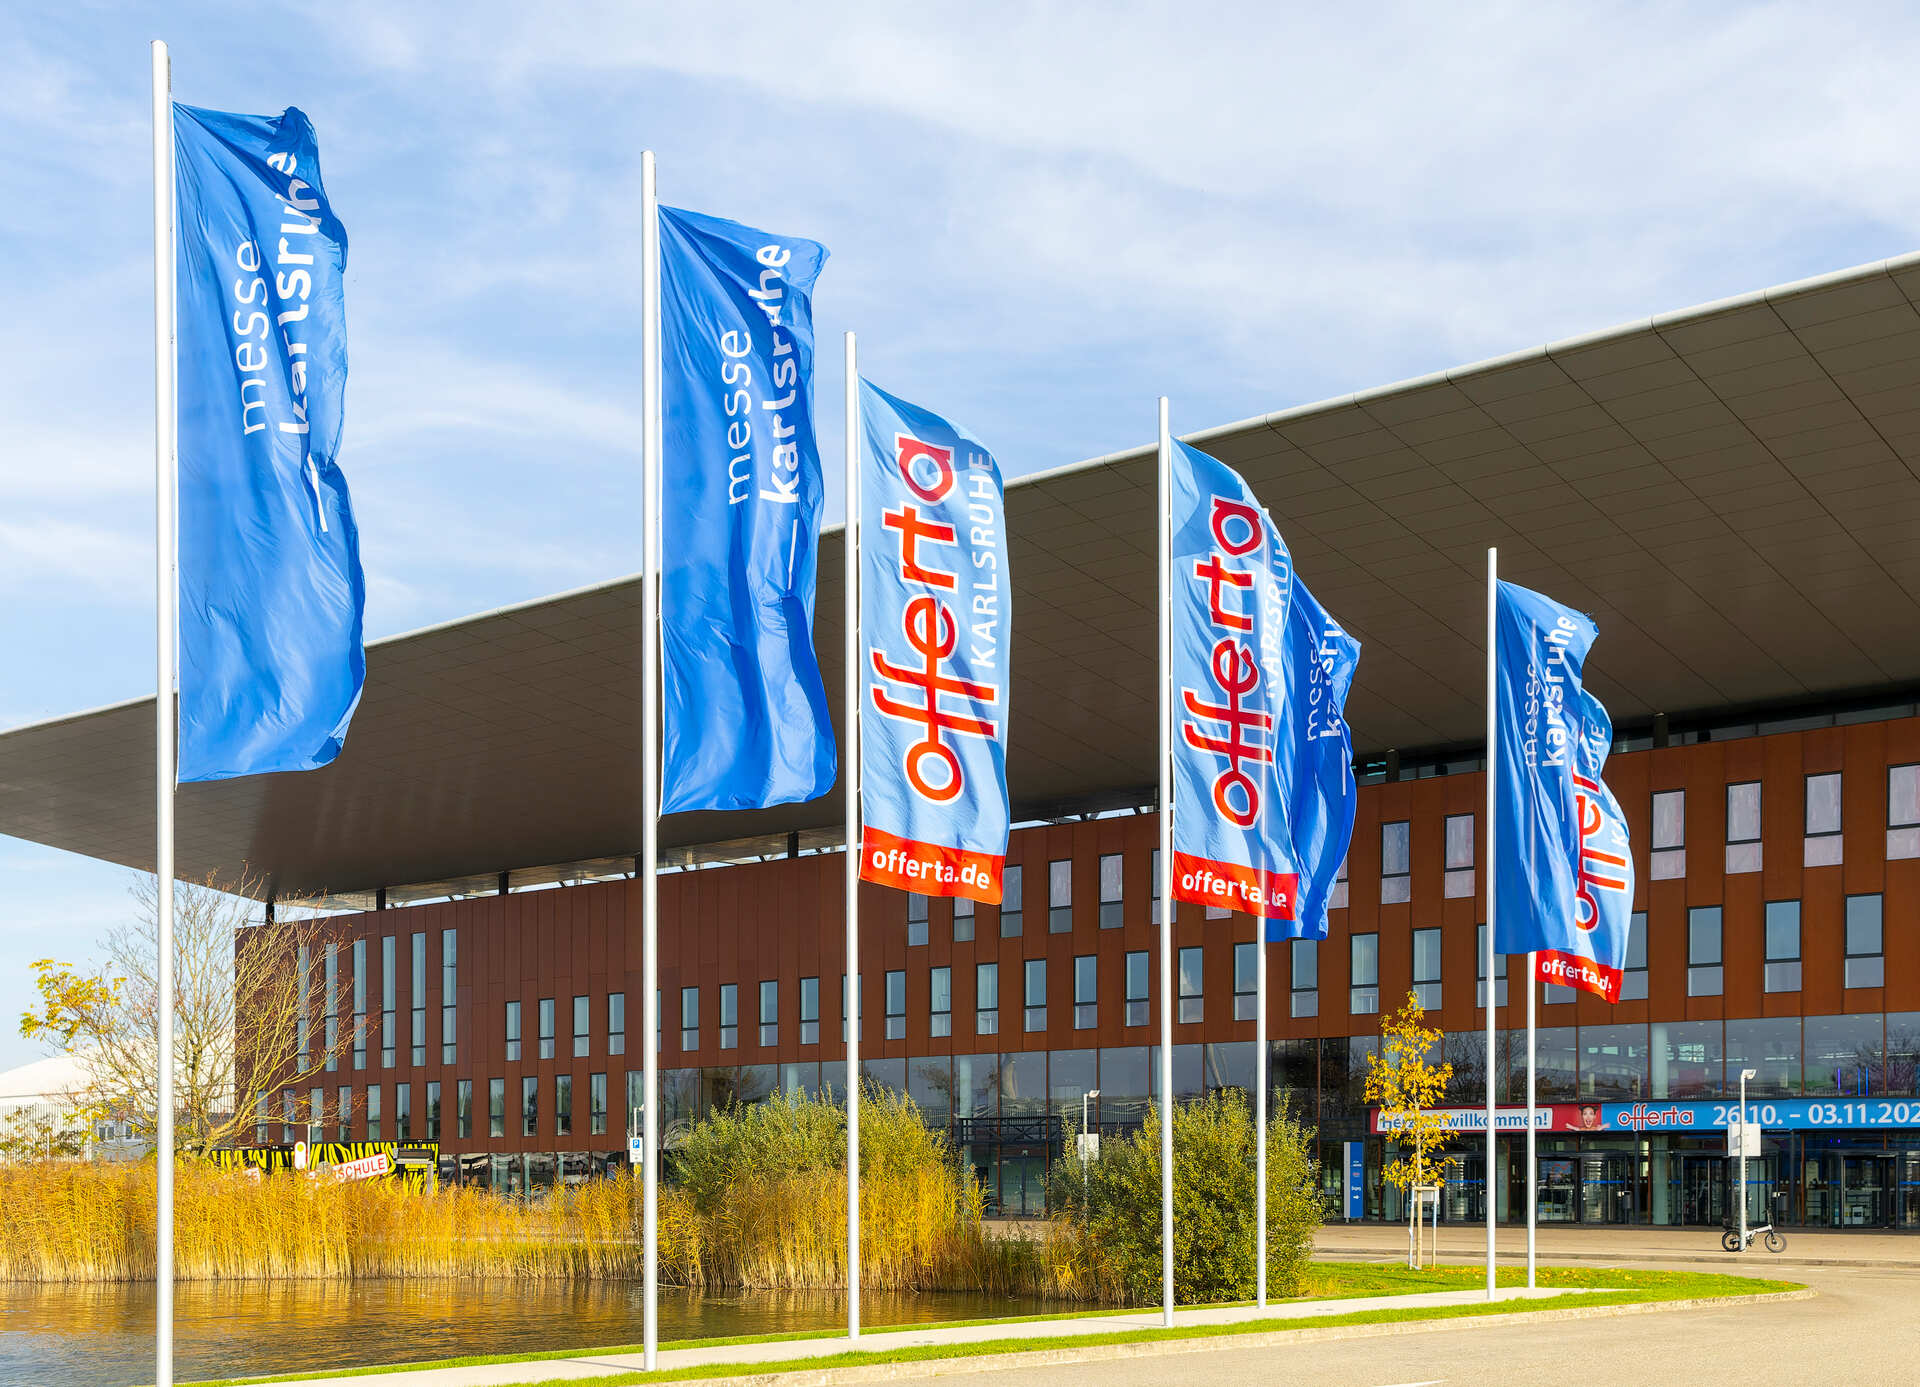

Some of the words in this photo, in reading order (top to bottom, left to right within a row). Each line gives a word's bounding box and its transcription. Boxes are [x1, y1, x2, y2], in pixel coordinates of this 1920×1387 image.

[233, 239, 269, 435] messe
[721, 329, 752, 505] messe
[870, 432, 999, 806] offerta
[968, 451, 998, 669] KARLSRUHE
[1260, 532, 1290, 699] KARLSRUH
[1180, 493, 1276, 831] offerta
[1525, 663, 1541, 768] messe
[1541, 615, 1579, 767] karlsruhe
[872, 849, 990, 890] offerta.de
[1617, 1103, 1694, 1131] offerta
